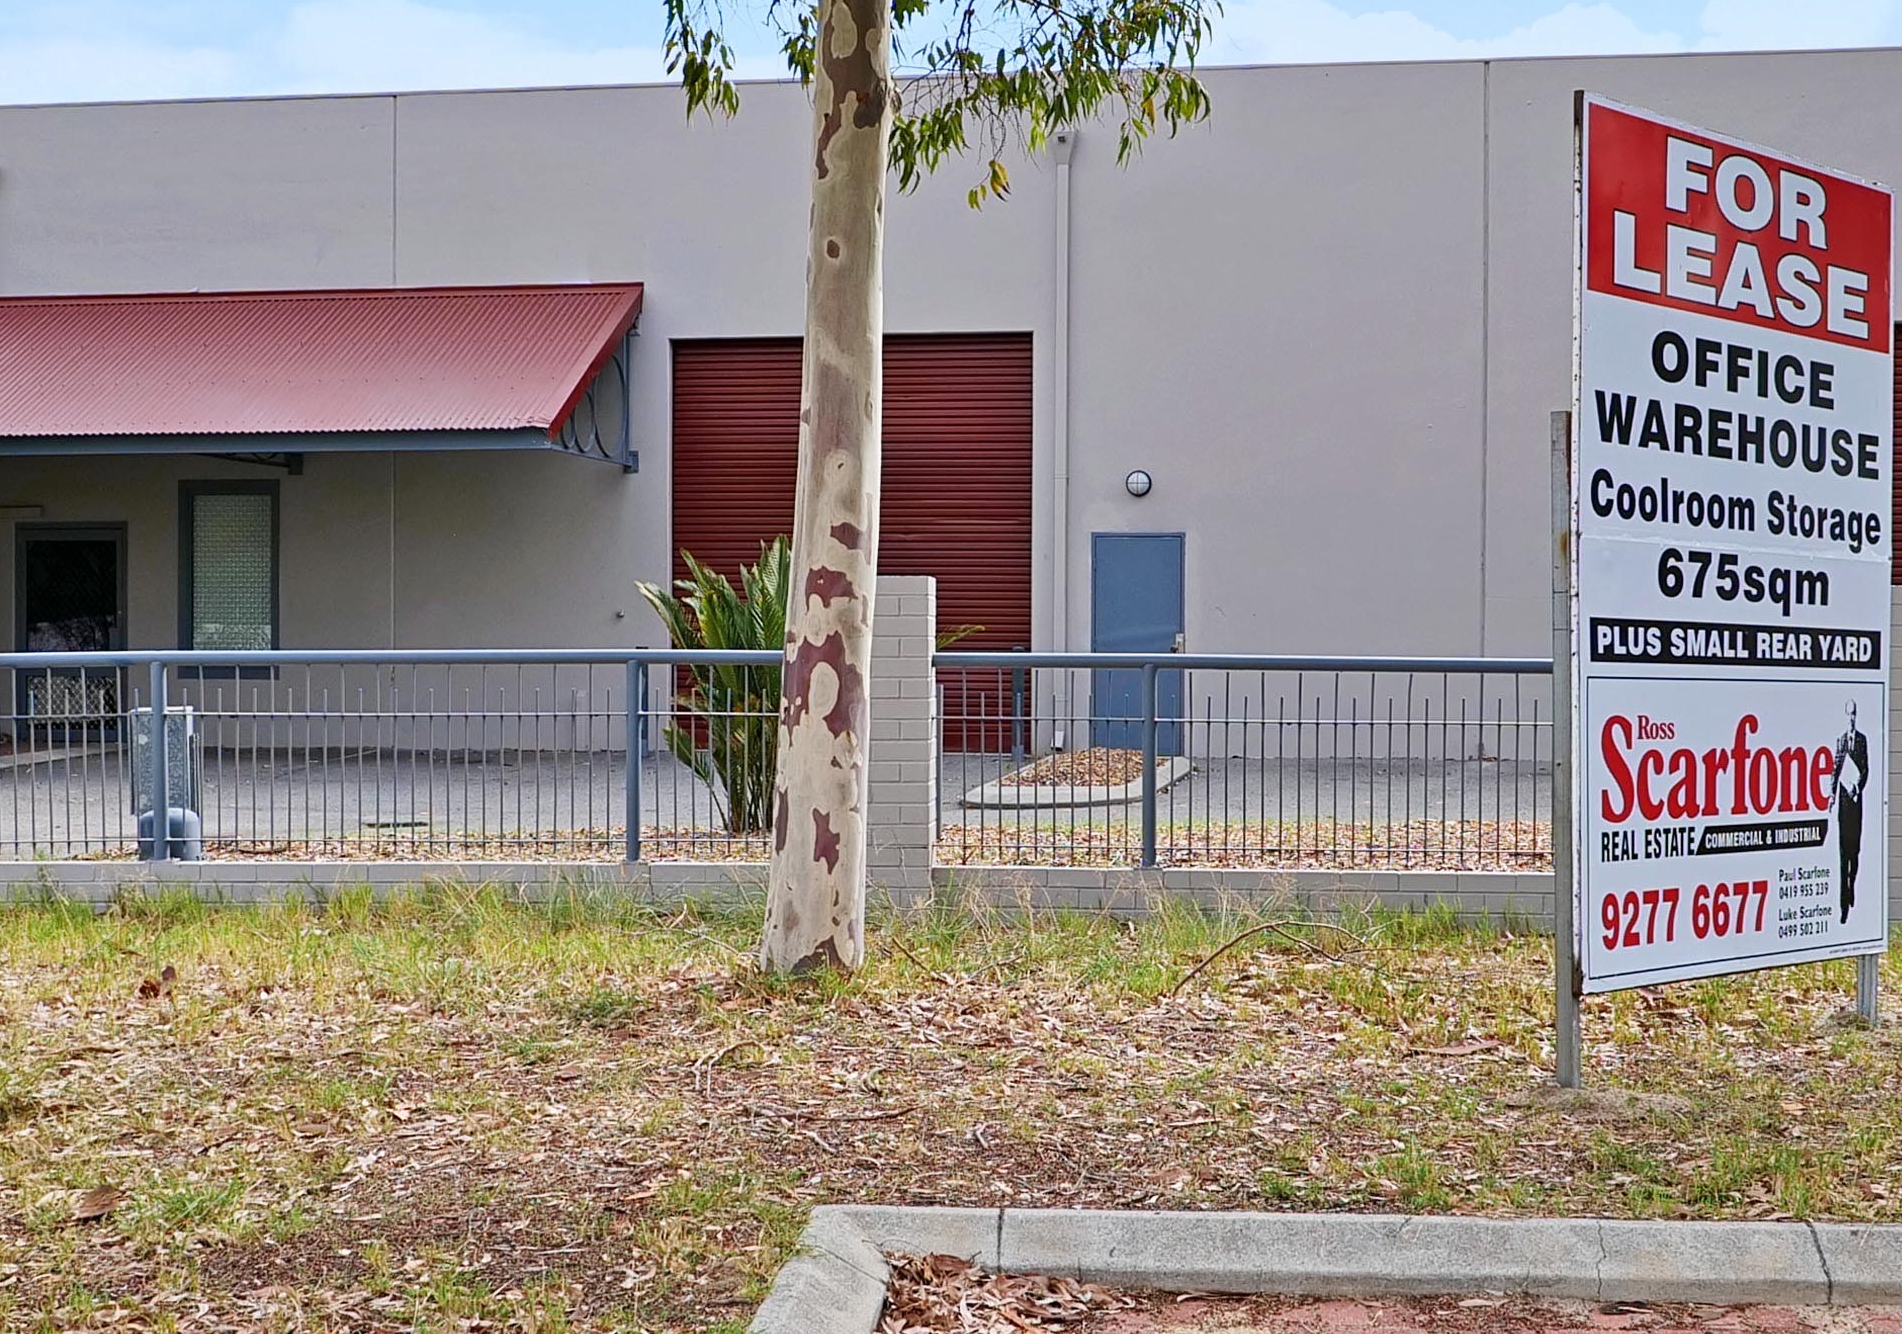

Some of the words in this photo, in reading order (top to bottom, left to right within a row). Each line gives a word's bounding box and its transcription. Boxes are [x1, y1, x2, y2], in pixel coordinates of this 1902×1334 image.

[1665, 135, 1828, 250] FOR
[1613, 209, 1870, 340] LEASE
[1651, 330, 1835, 410] OFFICE
[1594, 390, 1879, 480] WAREHOUSE
[1590, 468, 1756, 532] Coolroom
[1767, 491, 1881, 553] Storage
[1657, 547, 1829, 616] 675sqm
[1597, 625, 1662, 657] PLUS
[1670, 627, 1749, 660] SMALL
[1756, 632, 1813, 662] REAR
[1819, 634, 1873, 663] YARD
[1637, 714, 1675, 740] Ross
[1600, 713, 1835, 824] Scarfone
[1601, 830, 1639, 863] REAL
[1644, 826, 1696, 859] ESTATE
[1704, 829, 1764, 849] COMMERCIAL
[1766, 830, 1773, 845] &
[1775, 826, 1821, 844] INDUSTRIAL
[1778, 868, 1797, 882] Paul
[1798, 865, 1831, 881] Scarfone
[1779, 885, 1798, 900] 0419
[1601, 887, 1680, 951] 9277
[1691, 879, 1769, 940] 6677
[1778, 907, 1798, 922] Luke
[1800, 904, 1832, 919] Scarfone
